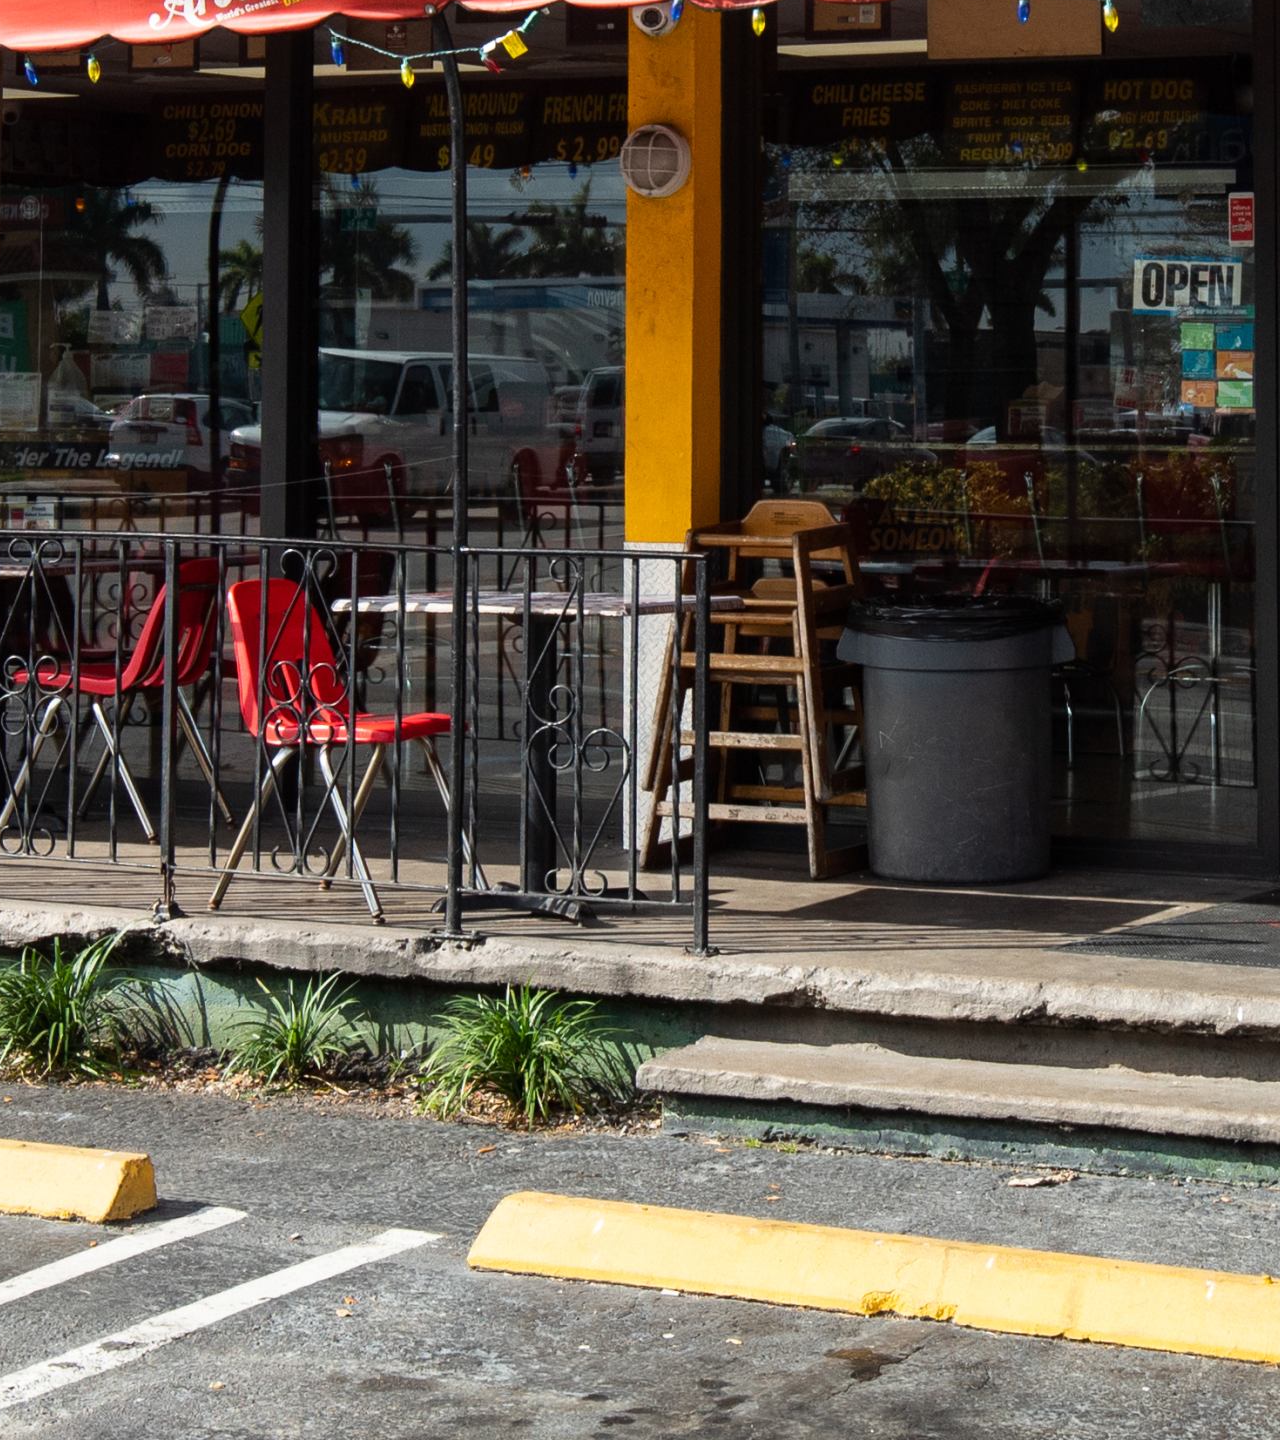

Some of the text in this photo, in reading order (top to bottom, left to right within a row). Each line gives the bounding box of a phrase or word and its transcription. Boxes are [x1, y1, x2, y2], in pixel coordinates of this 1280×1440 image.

[812, 81, 927, 104] CHILI CHEESE
[1048, 80, 1073, 93] TEA
[1104, 78, 1195, 101] HOT DOG
[162, 101, 263, 120] CHILI ONION
[543, 94, 604, 125] FRENCH
[959, 97, 1063, 111] COKE DIET COKE
[841, 106, 892, 127] FRIES
[951, 114, 1071, 128] SPRITE ROOT BEER
[966, 132, 1003, 144] FRUIT
[164, 141, 253, 159] CORN DOG
[1141, 261, 1235, 308] OPEN
[55, 446, 91, 467] The
